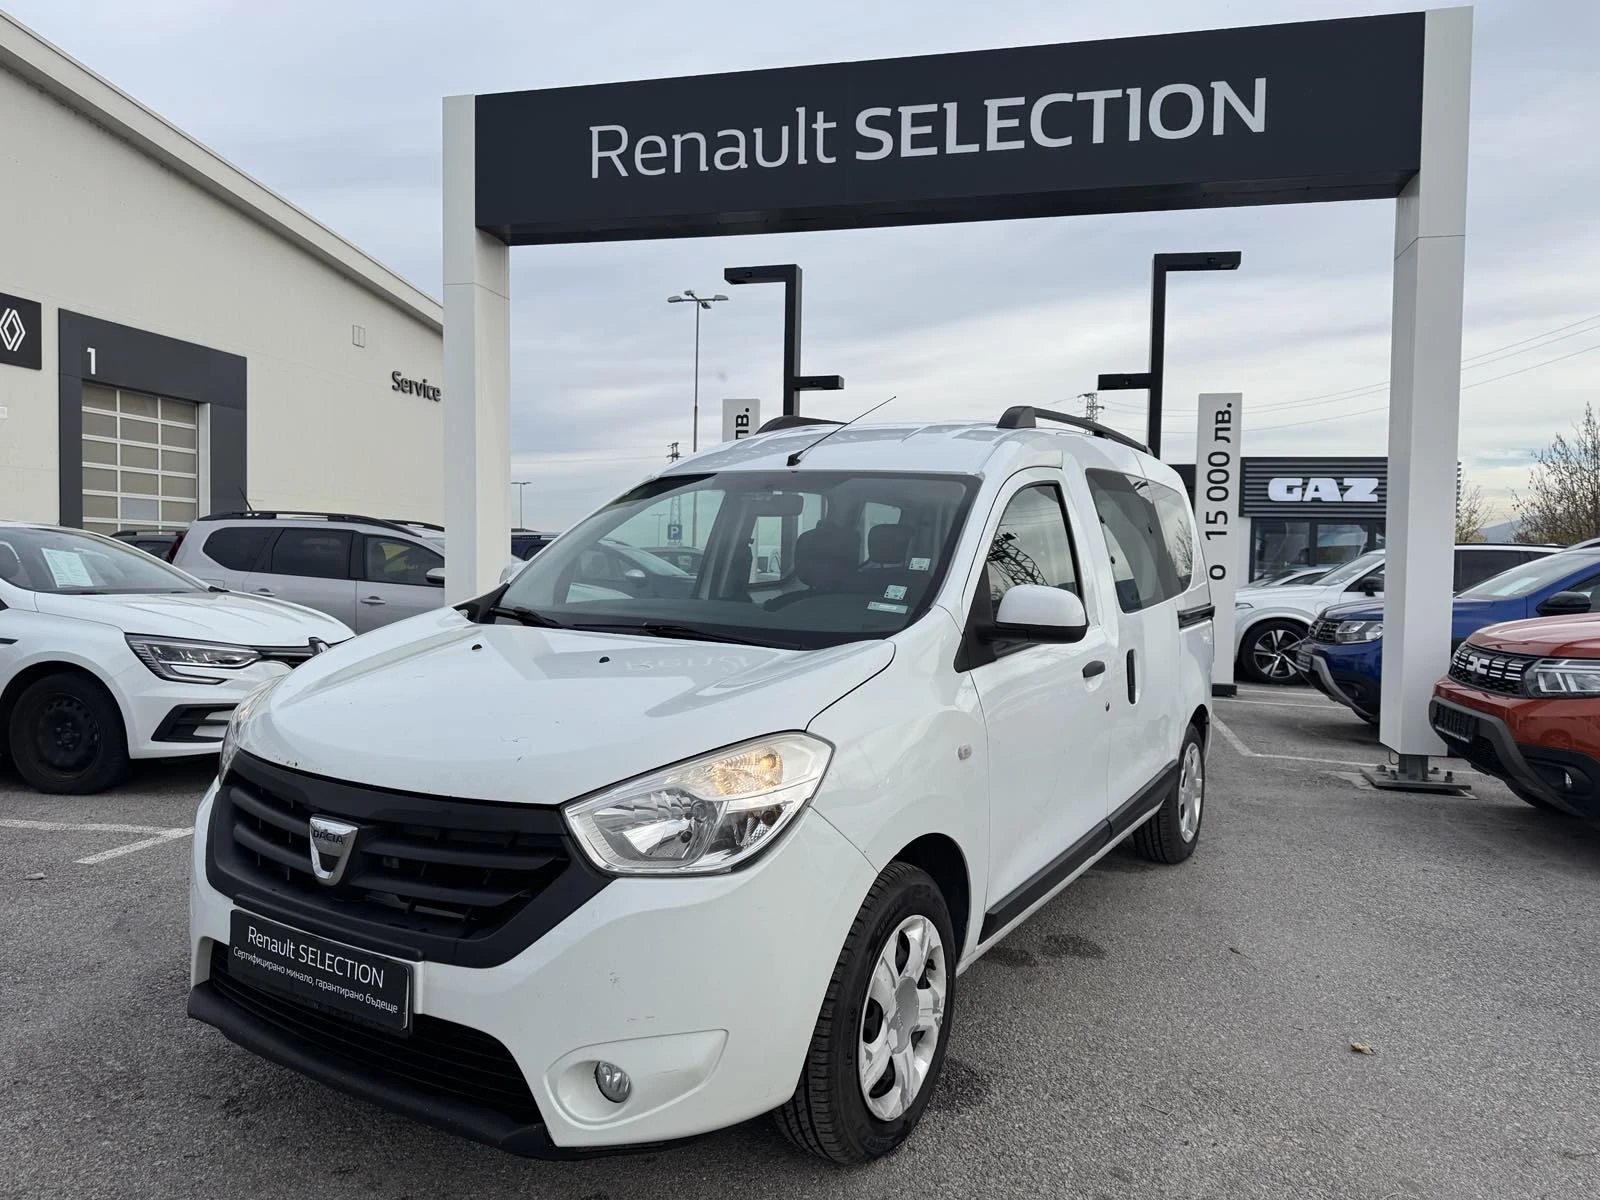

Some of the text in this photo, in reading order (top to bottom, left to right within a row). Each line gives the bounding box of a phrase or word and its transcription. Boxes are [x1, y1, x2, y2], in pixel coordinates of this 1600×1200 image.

[589, 77, 1267, 179] Renault SELECTION
[87, 347, 96, 375] 1
[391, 370, 442, 403] Service
[1206, 451, 1231, 502] 000
[1267, 477, 1379, 503] GAZ
[670, 526, 680, 539] P
[1205, 509, 1228, 541] 15
[313, 829, 344, 845] DACIA
[247, 925, 384, 989] Renault SELECTION
[233, 946, 399, 1014] Сертифицирано минало, гарантирано бъдеще
